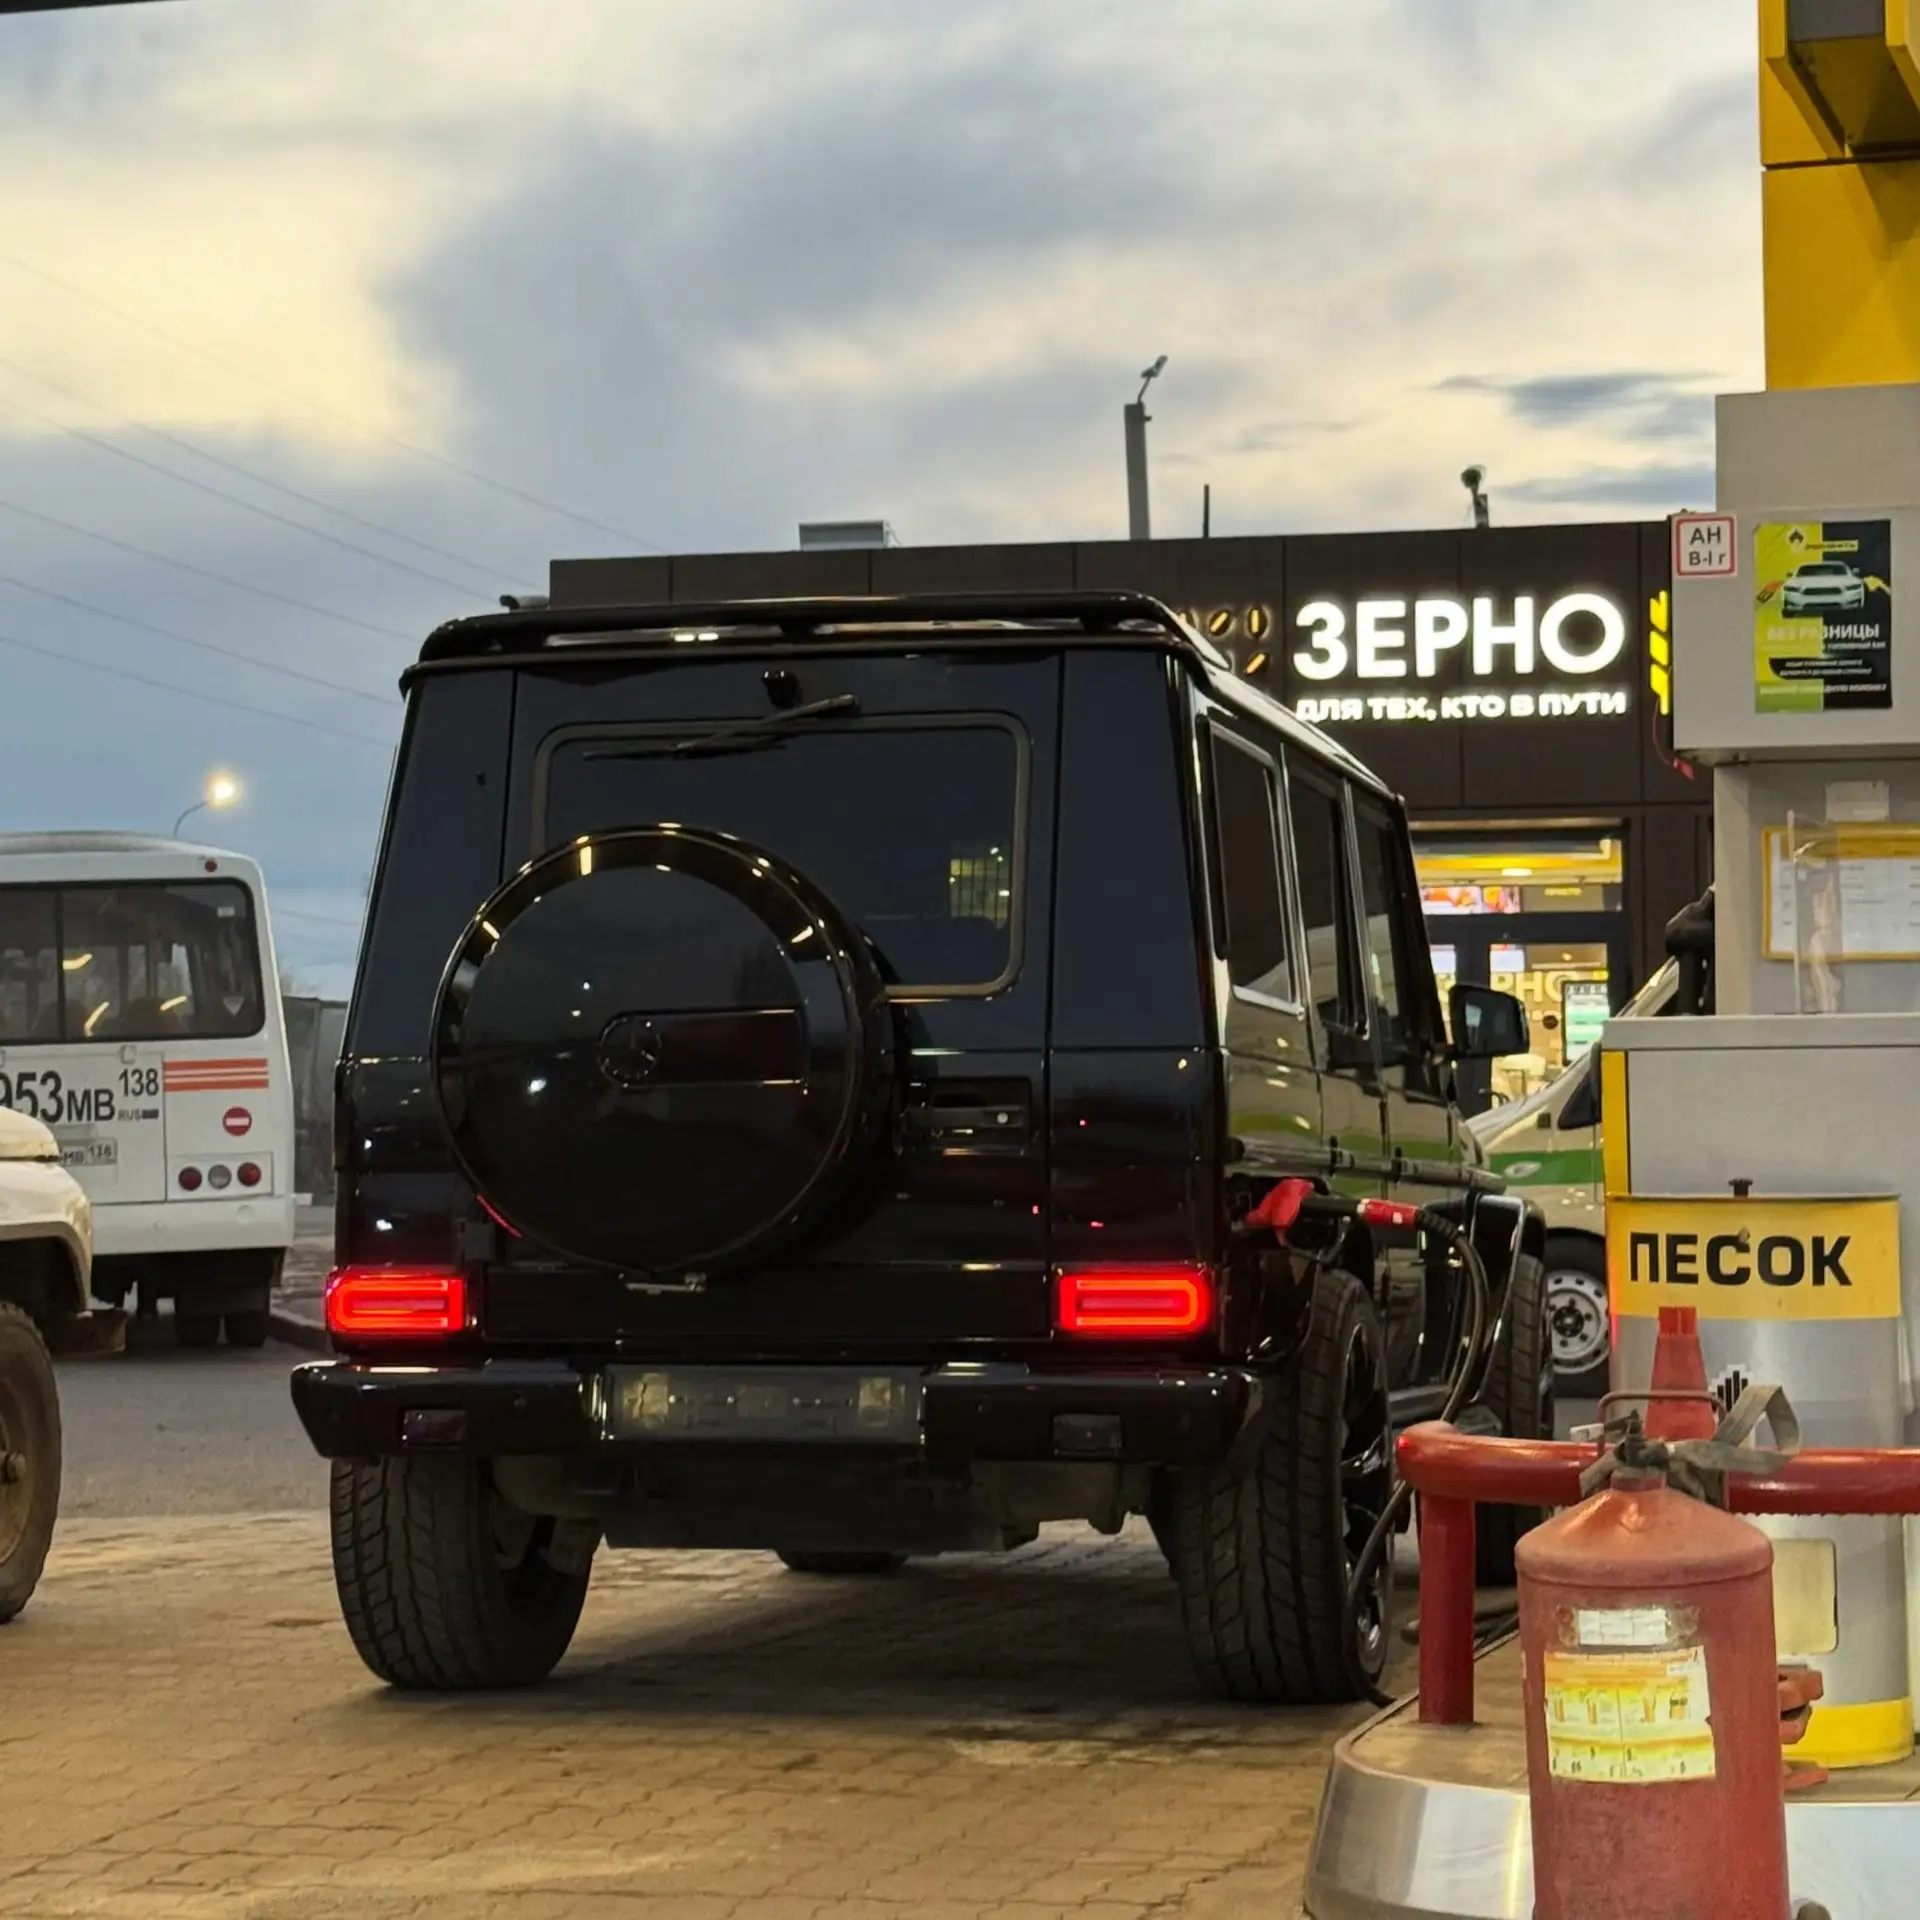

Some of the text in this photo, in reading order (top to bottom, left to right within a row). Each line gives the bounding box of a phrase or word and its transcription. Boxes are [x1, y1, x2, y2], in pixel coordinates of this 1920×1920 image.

[1293, 593, 1625, 680] ЗЕРНО
[1295, 691, 1627, 723] ДЛЯ ТЕХ, КТО В ПУТИ
[118, 1068, 159, 1097] 138
[1630, 1231, 1852, 1287] ПЕСОК
